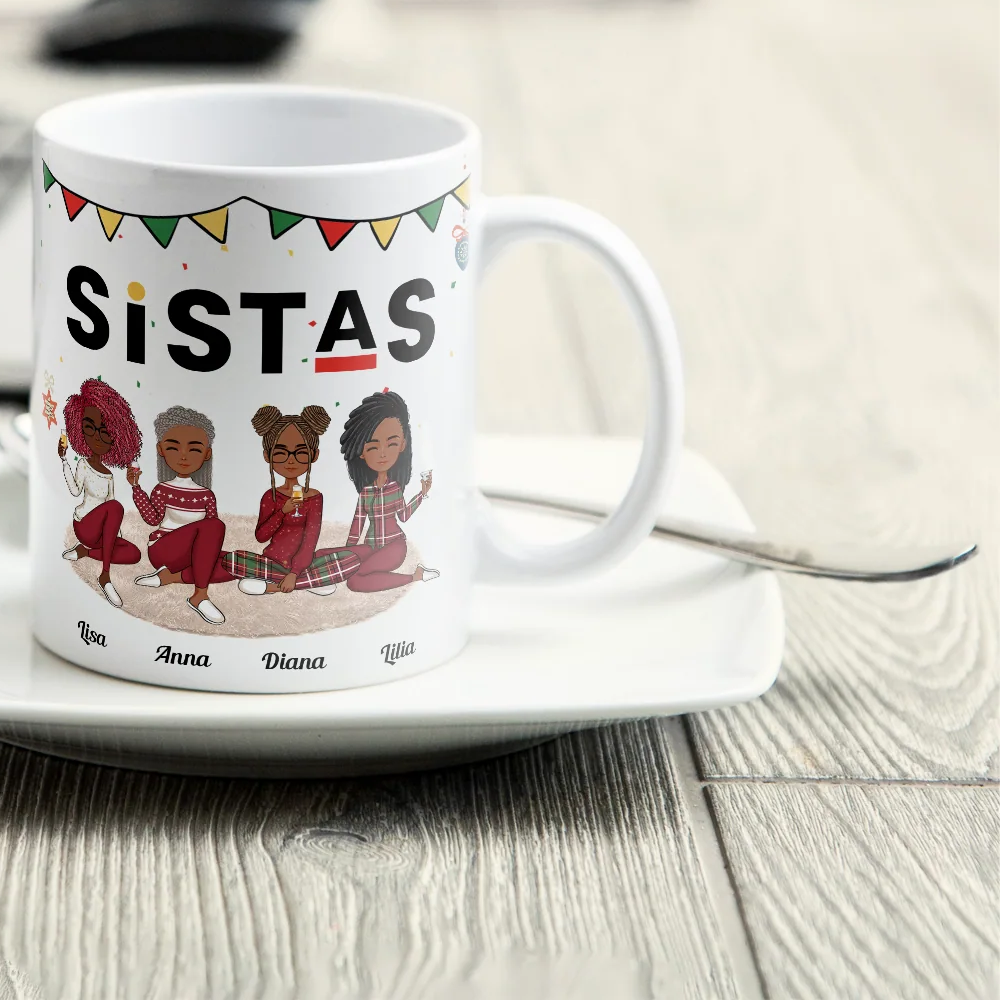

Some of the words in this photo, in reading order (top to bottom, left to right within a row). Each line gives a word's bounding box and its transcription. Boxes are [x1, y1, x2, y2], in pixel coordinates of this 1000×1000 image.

[77, 620, 109, 648] Lisa
[154, 645, 213, 669] Anna
[261, 652, 328, 670] Diana
[380, 640, 417, 666] Lilia
